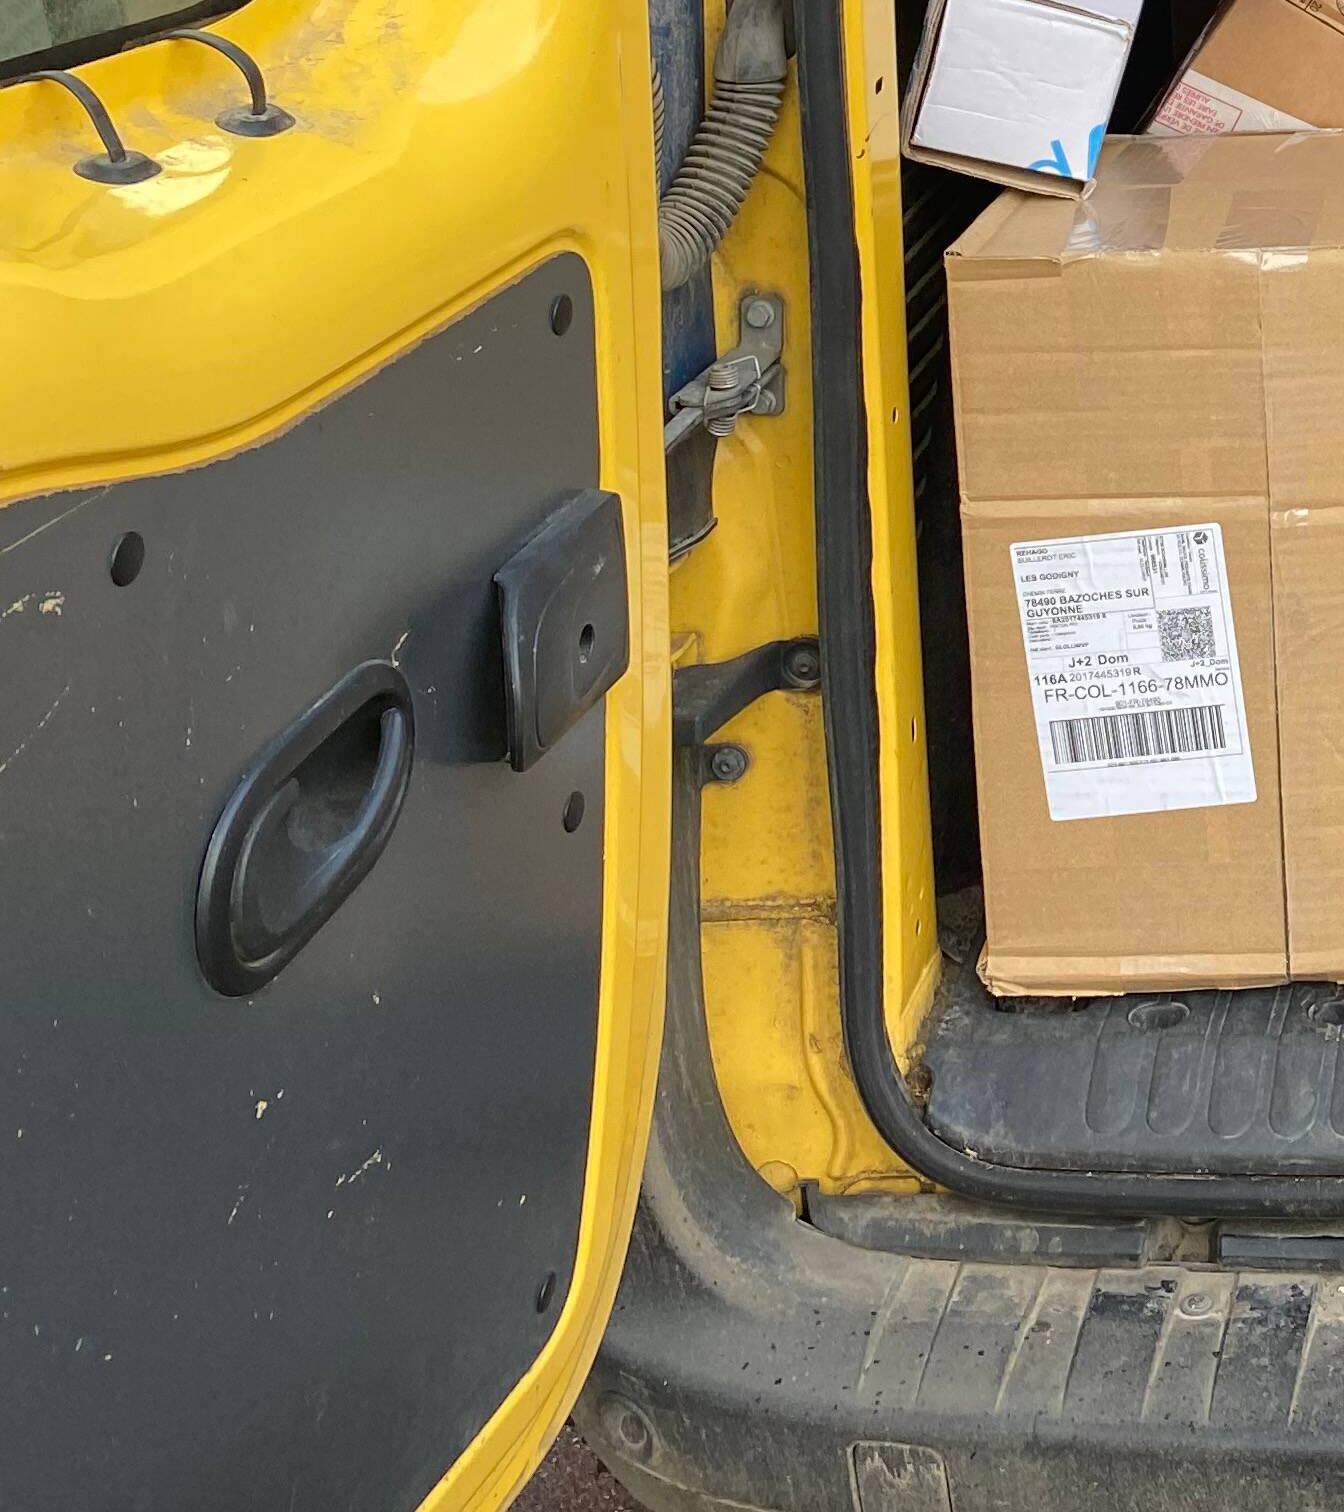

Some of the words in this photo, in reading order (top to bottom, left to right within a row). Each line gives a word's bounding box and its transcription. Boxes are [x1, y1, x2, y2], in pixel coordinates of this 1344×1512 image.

[1197, 548, 1210, 590] colissimo
[1024, 596, 1057, 608] 78490
[1059, 590, 1123, 605] BAZOCHES
[1125, 587, 1150, 598] SUR
[1026, 604, 1083, 619] GUYONNE
[1068, 656, 1092, 669] J+2
[1097, 653, 1129, 666] Dom
[1132, 667, 1142, 676] R
[1044, 671, 1229, 704] FR-COL-1166-78MMO
